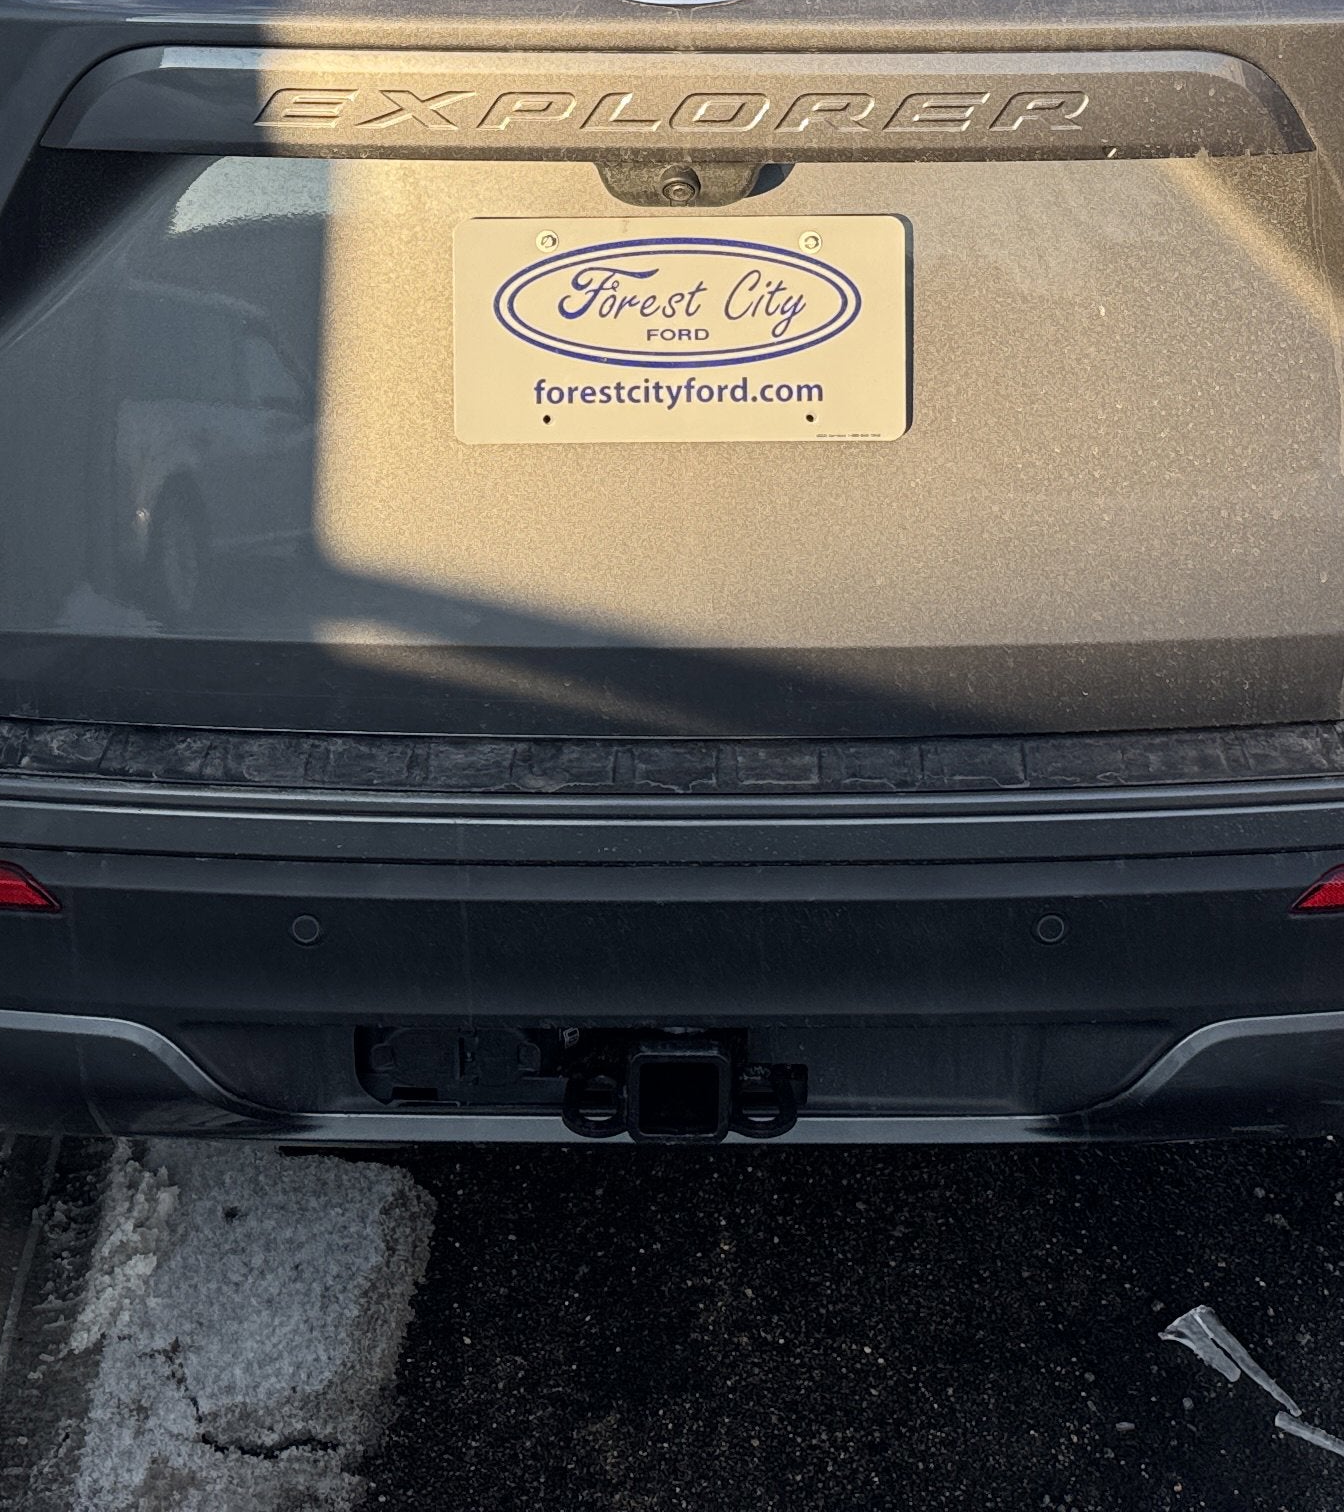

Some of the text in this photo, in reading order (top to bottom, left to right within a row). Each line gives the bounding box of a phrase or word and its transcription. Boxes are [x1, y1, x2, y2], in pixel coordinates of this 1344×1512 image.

[255, 88, 1090, 133] EXPLORER
[557, 267, 807, 338] Forest City
[646, 328, 710, 341] FORD
[534, 377, 824, 410] forestcityford.com
